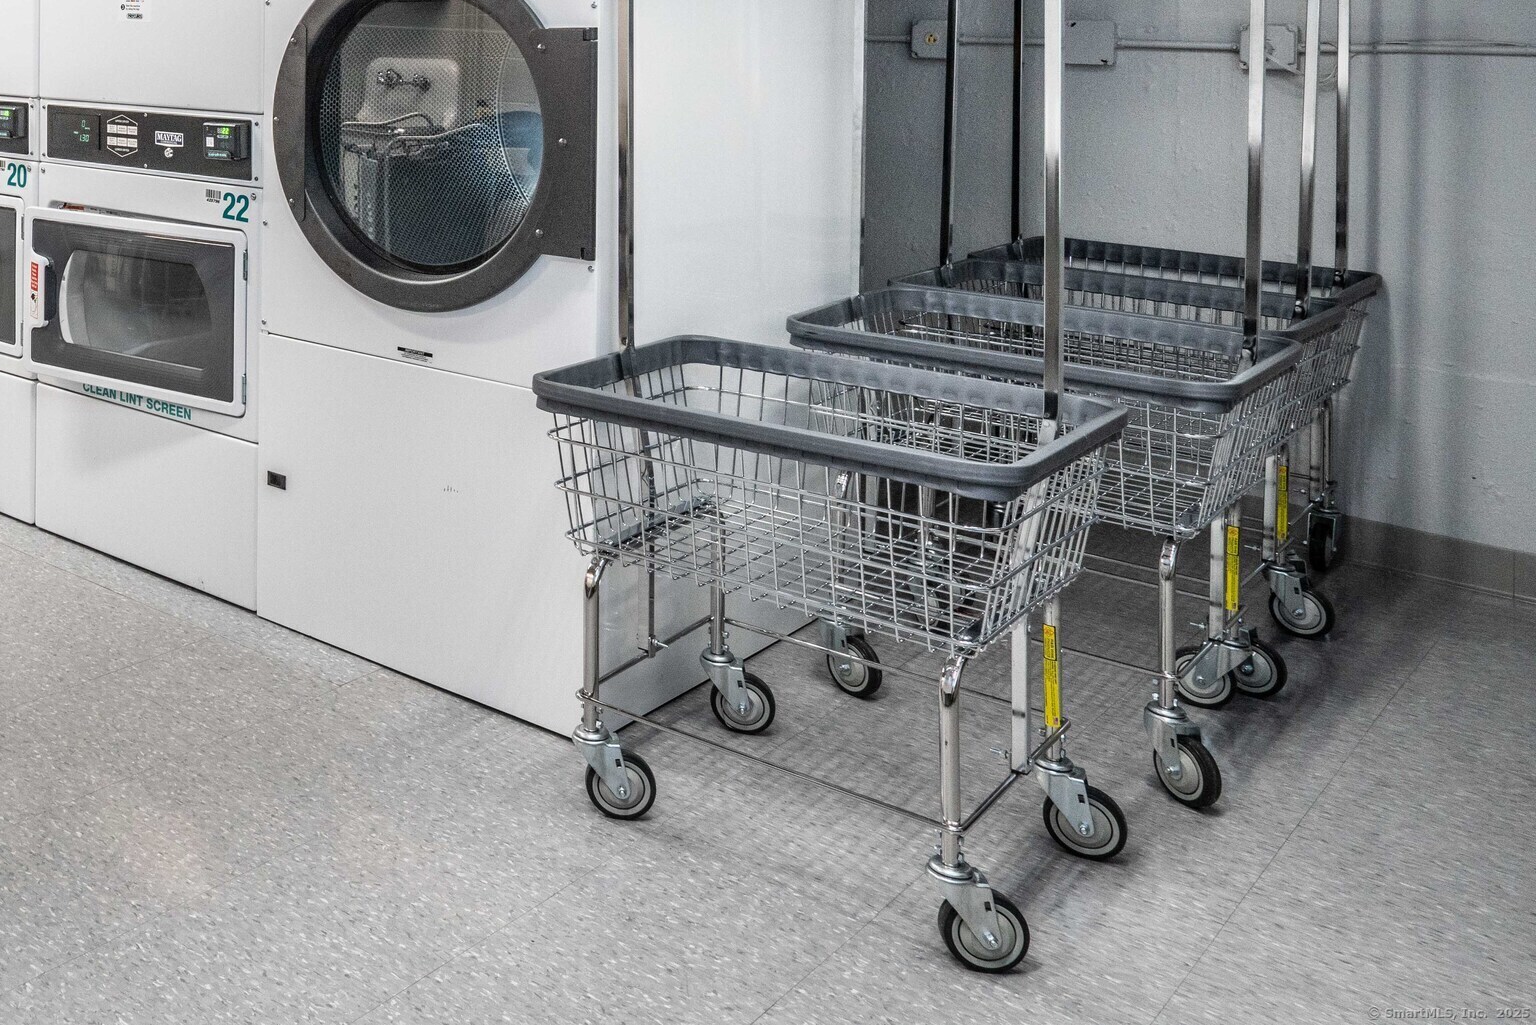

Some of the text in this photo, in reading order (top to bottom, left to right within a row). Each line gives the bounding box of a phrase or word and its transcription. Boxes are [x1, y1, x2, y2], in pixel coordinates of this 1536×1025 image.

[157, 132, 182, 142] MAYTAG
[7, 162, 27, 188] 20
[222, 192, 250, 223] 22
[83, 383, 192, 420] CLEAN LINT SCREEN
